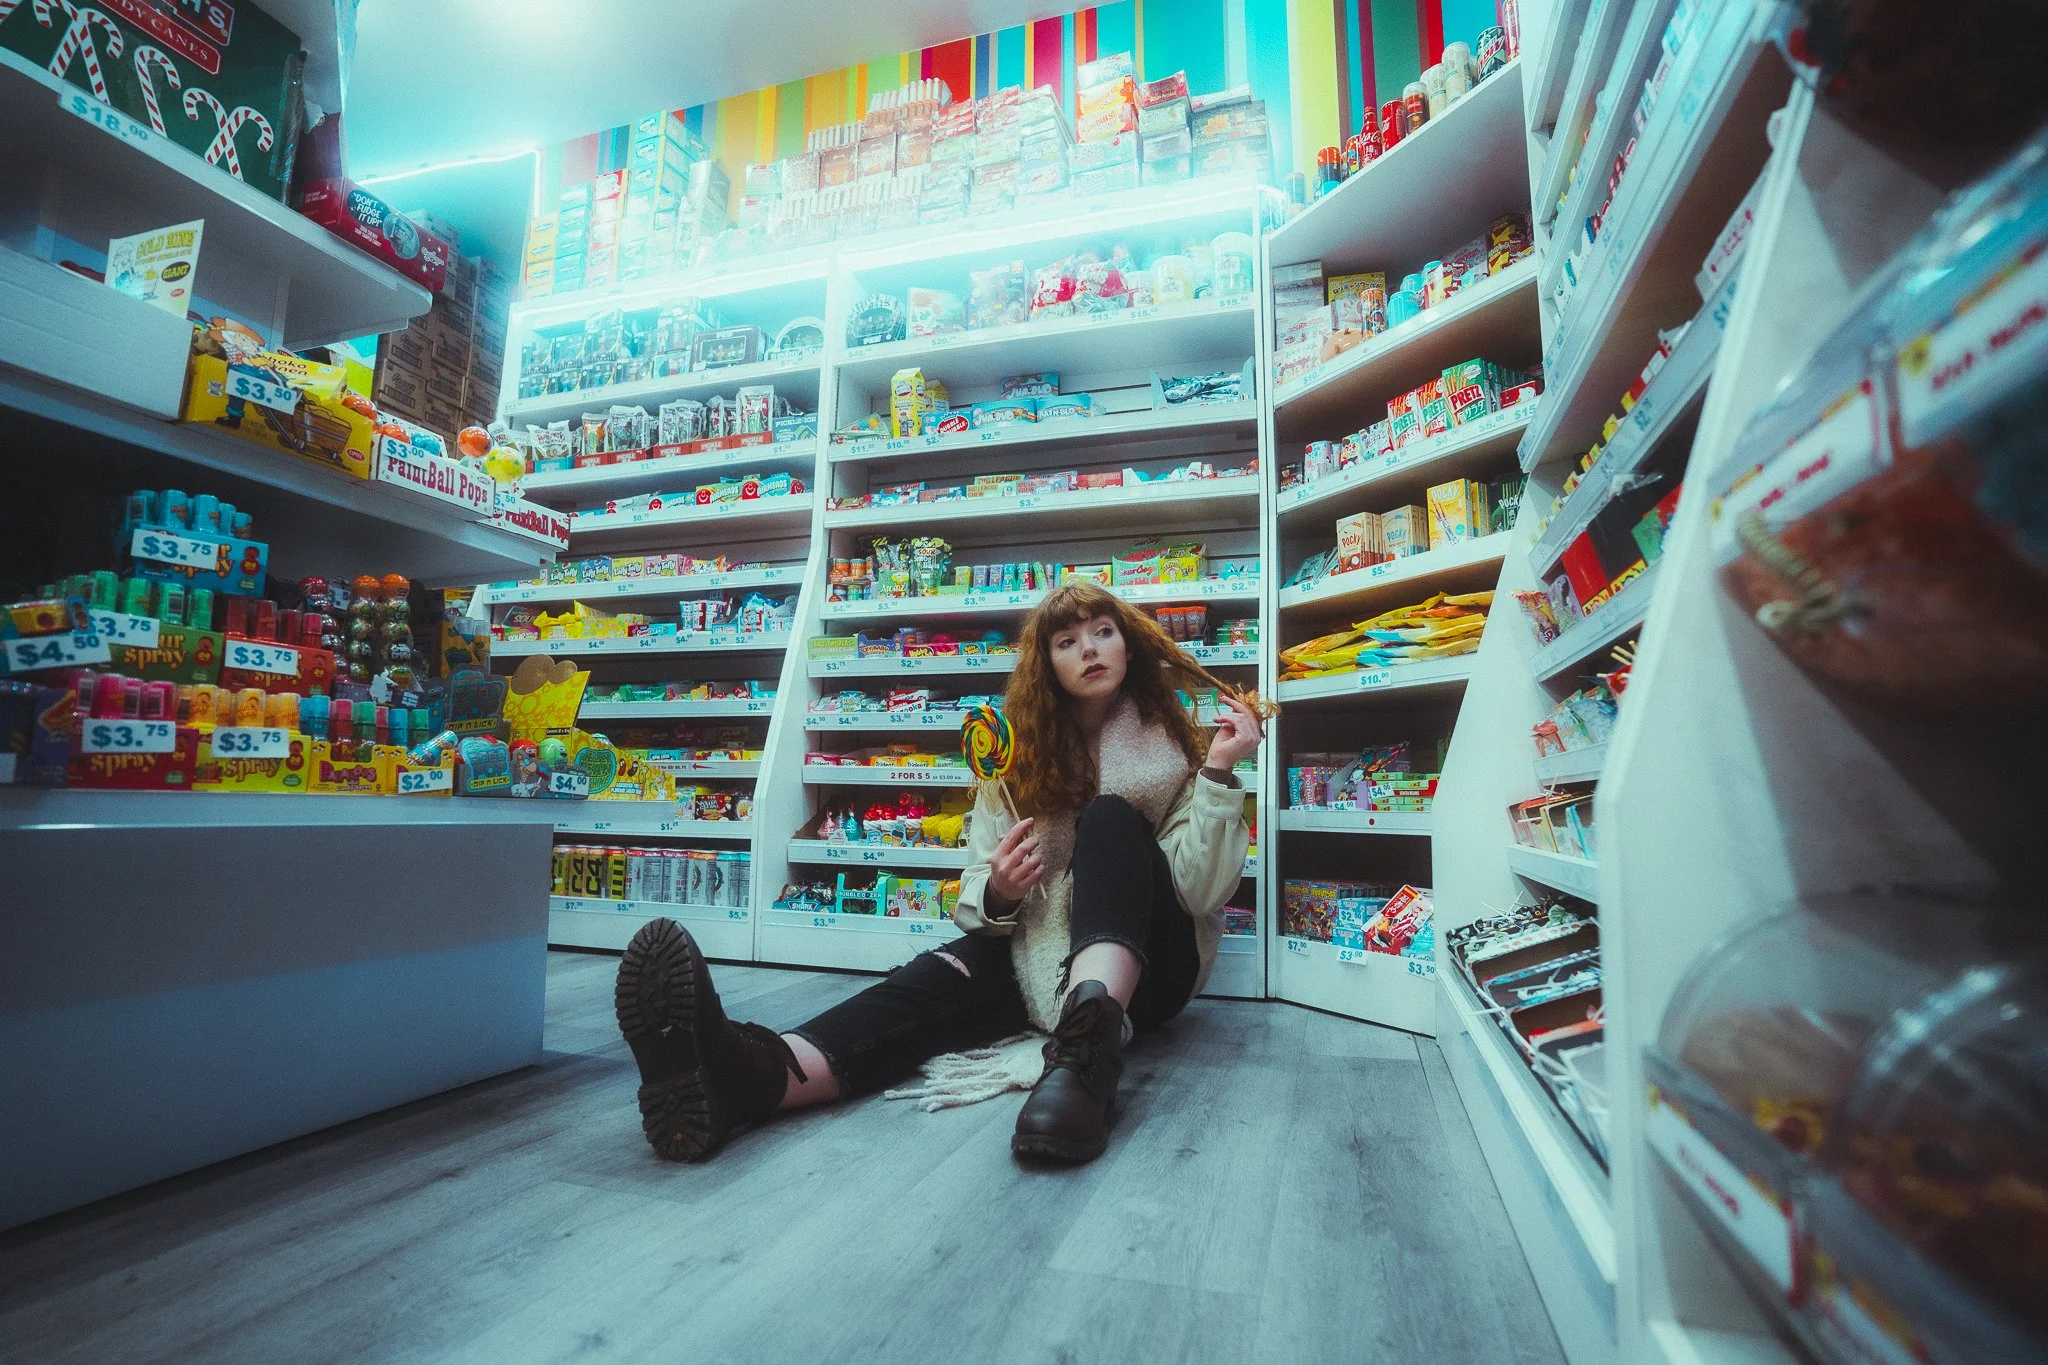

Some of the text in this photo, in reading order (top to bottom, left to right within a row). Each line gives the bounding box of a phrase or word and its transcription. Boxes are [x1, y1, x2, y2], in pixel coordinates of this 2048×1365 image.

[150, 18, 209, 60] CANES
[72, 95, 149, 141] $18.00
[356, 204, 382, 219] FUDGE
[359, 213, 367, 222] IT
[163, 263, 190, 280] GIANT
[267, 355, 308, 370] hoko
[235, 377, 292, 404] $3.50
[1451, 386, 1482, 411] PRETZ
[939, 418, 959, 433] DUBBLE
[1392, 412, 1417, 437] PRETZ
[387, 439, 425, 459] $3.00
[887, 439, 910, 450] $10.00
[387, 456, 488, 507] PaintBall Pops
[1431, 485, 1460, 500] POCKY
[1387, 528, 1408, 541] POCKY
[141, 535, 213, 561] $3.75
[1341, 536, 1362, 548] POCKY
[563, 566, 579, 579] Taffy
[595, 564, 609, 576] Taffy
[627, 562, 643, 574] Taffy
[660, 560, 676, 573] Taffy
[1371, 563, 1392, 577] $5.00
[1301, 579, 1320, 593] $8.00
[964, 597, 985, 605] $3.50
[90, 616, 151, 638] $3.75
[15, 635, 100, 666] $4.50
[233, 646, 293, 668] $3.75
[1195, 646, 1220, 658] $2.00
[1232, 649, 1257, 659] $2.00
[123, 648, 188, 671] spray
[901, 659, 922, 668] $2.50
[1360, 671, 1390, 686] $10.00
[449, 719, 493, 732] DIP LICK
[806, 717, 826, 725] $4.50
[91, 724, 168, 747] $3.75
[217, 731, 282, 752] $3.75
[892, 749, 913, 757] Trident
[90, 752, 159, 778] spray
[222, 757, 284, 782] spray
[401, 771, 444, 793] $2.00
[473, 776, 509, 787] DIP LICK
[555, 775, 588, 791] $4.00
[890, 772, 896, 780] 2
[898, 772, 916, 780] FOR
[917, 772, 923, 780] $
[925, 772, 931, 780] 5
[1371, 783, 1391, 797] $4.00
[869, 835, 883, 843] ICE
[826, 849, 848, 859] $3.50
[863, 851, 885, 861] $4.00
[571, 857, 585, 894] C4
[585, 856, 604, 896] C4
[838, 891, 861, 899] BUBBLE
[791, 902, 814, 912] SHARK
[813, 917, 836, 928] $3.50
[1341, 910, 1363, 923] $2.50
[910, 924, 933, 934] $3.50
[1339, 950, 1363, 961] $3.00
[1407, 961, 1435, 977] $3.50
